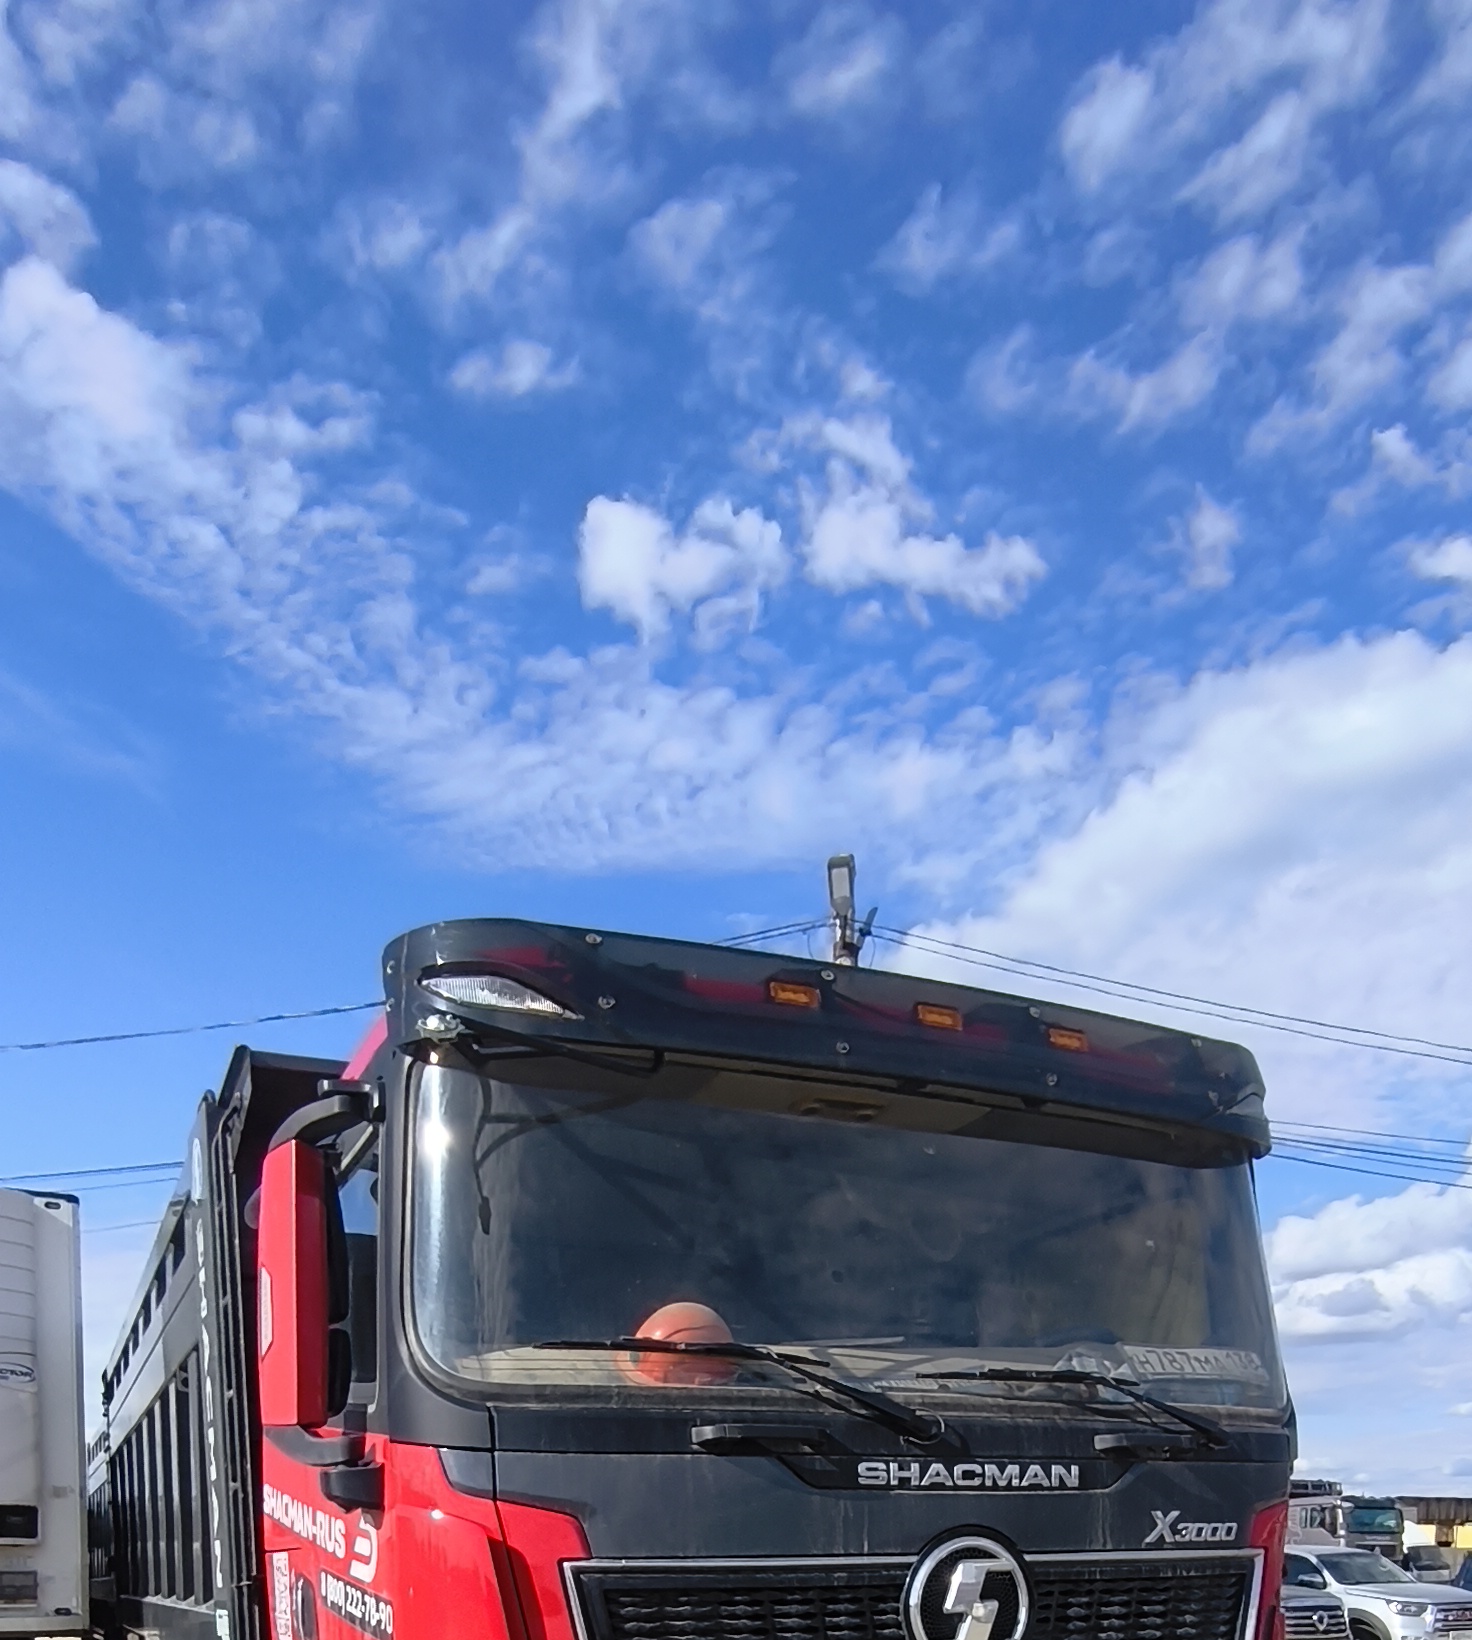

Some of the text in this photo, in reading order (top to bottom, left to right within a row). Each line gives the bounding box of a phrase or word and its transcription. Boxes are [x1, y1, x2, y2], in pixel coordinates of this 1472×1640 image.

[857, 1461, 1080, 1488] SHACMAN
[263, 1483, 346, 1559] SHACMAN-RUS
[1144, 1509, 1238, 1543] X3000
